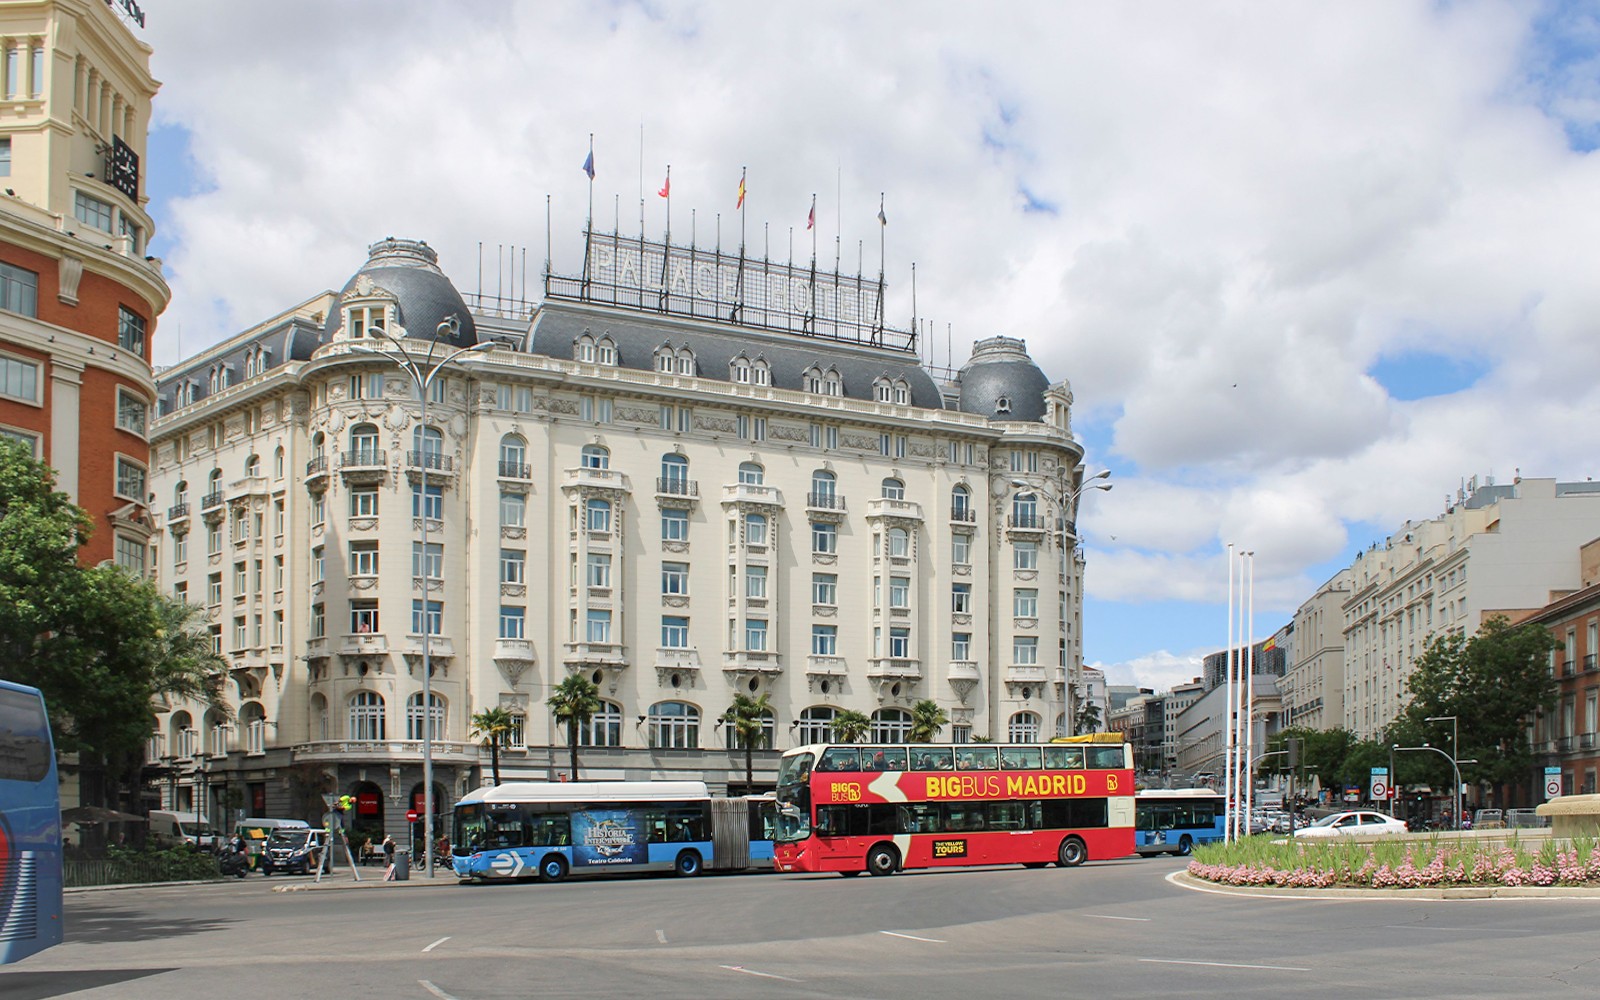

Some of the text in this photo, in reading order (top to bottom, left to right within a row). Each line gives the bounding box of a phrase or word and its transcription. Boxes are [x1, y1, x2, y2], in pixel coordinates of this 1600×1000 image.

[594, 245, 879, 325] PALACE HOTEL
[831, 782, 848, 793] BIG
[1007, 775, 1086, 796] MADRID
[831, 792, 848, 802] BUS
[587, 826, 627, 838] HISTORIA
[935, 845, 965, 853] TOURS
